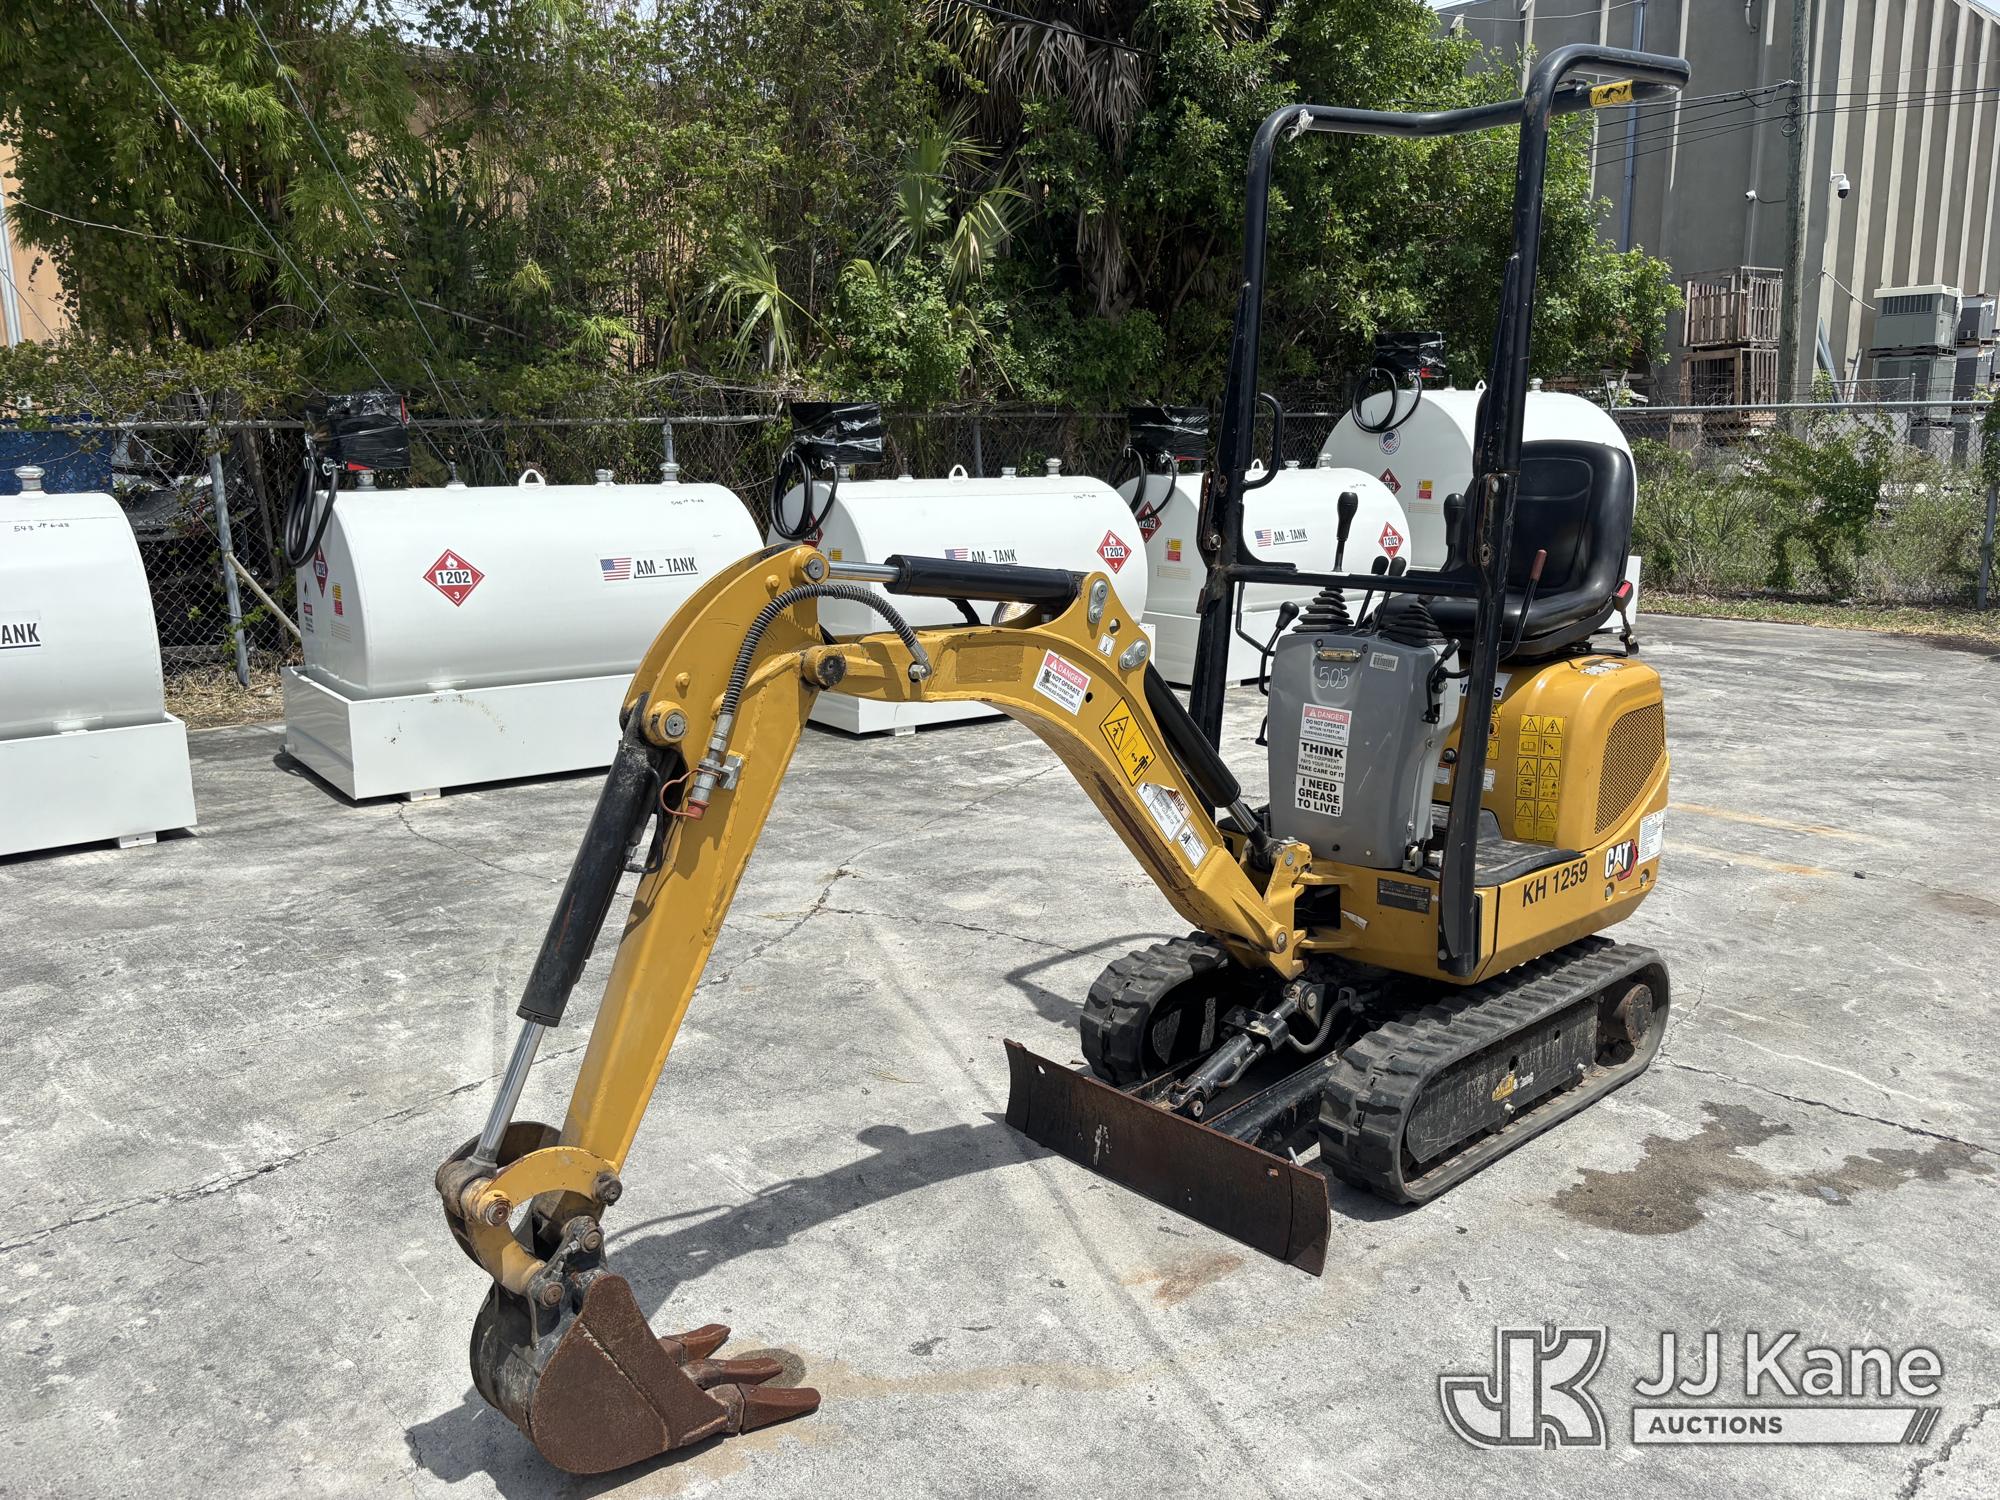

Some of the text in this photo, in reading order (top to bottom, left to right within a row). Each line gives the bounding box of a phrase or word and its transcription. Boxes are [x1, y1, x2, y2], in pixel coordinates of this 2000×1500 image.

[1274, 530, 1285, 542] AM
[1289, 528, 1307, 540] TANK
[1384, 536, 1397, 545] 1202
[972, 551, 986, 563] AM
[993, 549, 1017, 562] TANK
[1105, 547, 1123, 557] 1202
[636, 560, 656, 575] AM
[665, 557, 697, 573] TANK
[438, 571, 470, 584] 1202
[453, 591, 460, 599] 3
[1, 623, 40, 644] ANK
[1057, 664, 1083, 686] DANGER
[1317, 666, 1350, 689] 505
[1061, 680, 1081, 696] OPERATE
[1317, 711, 1344, 722] DANGER
[1324, 722, 1345, 730] OPERATE
[1301, 742, 1343, 758] THINK
[1314, 755, 1340, 763] EQUIPMENT
[1298, 764, 1312, 772] TAKE
[1302, 777, 1336, 792] I NEED
[1298, 788, 1340, 804] GREASE
[1297, 798, 1340, 815] TO LIVE!
[1605, 841, 1631, 878] CAT
[1523, 860, 1588, 907] KH 1259
